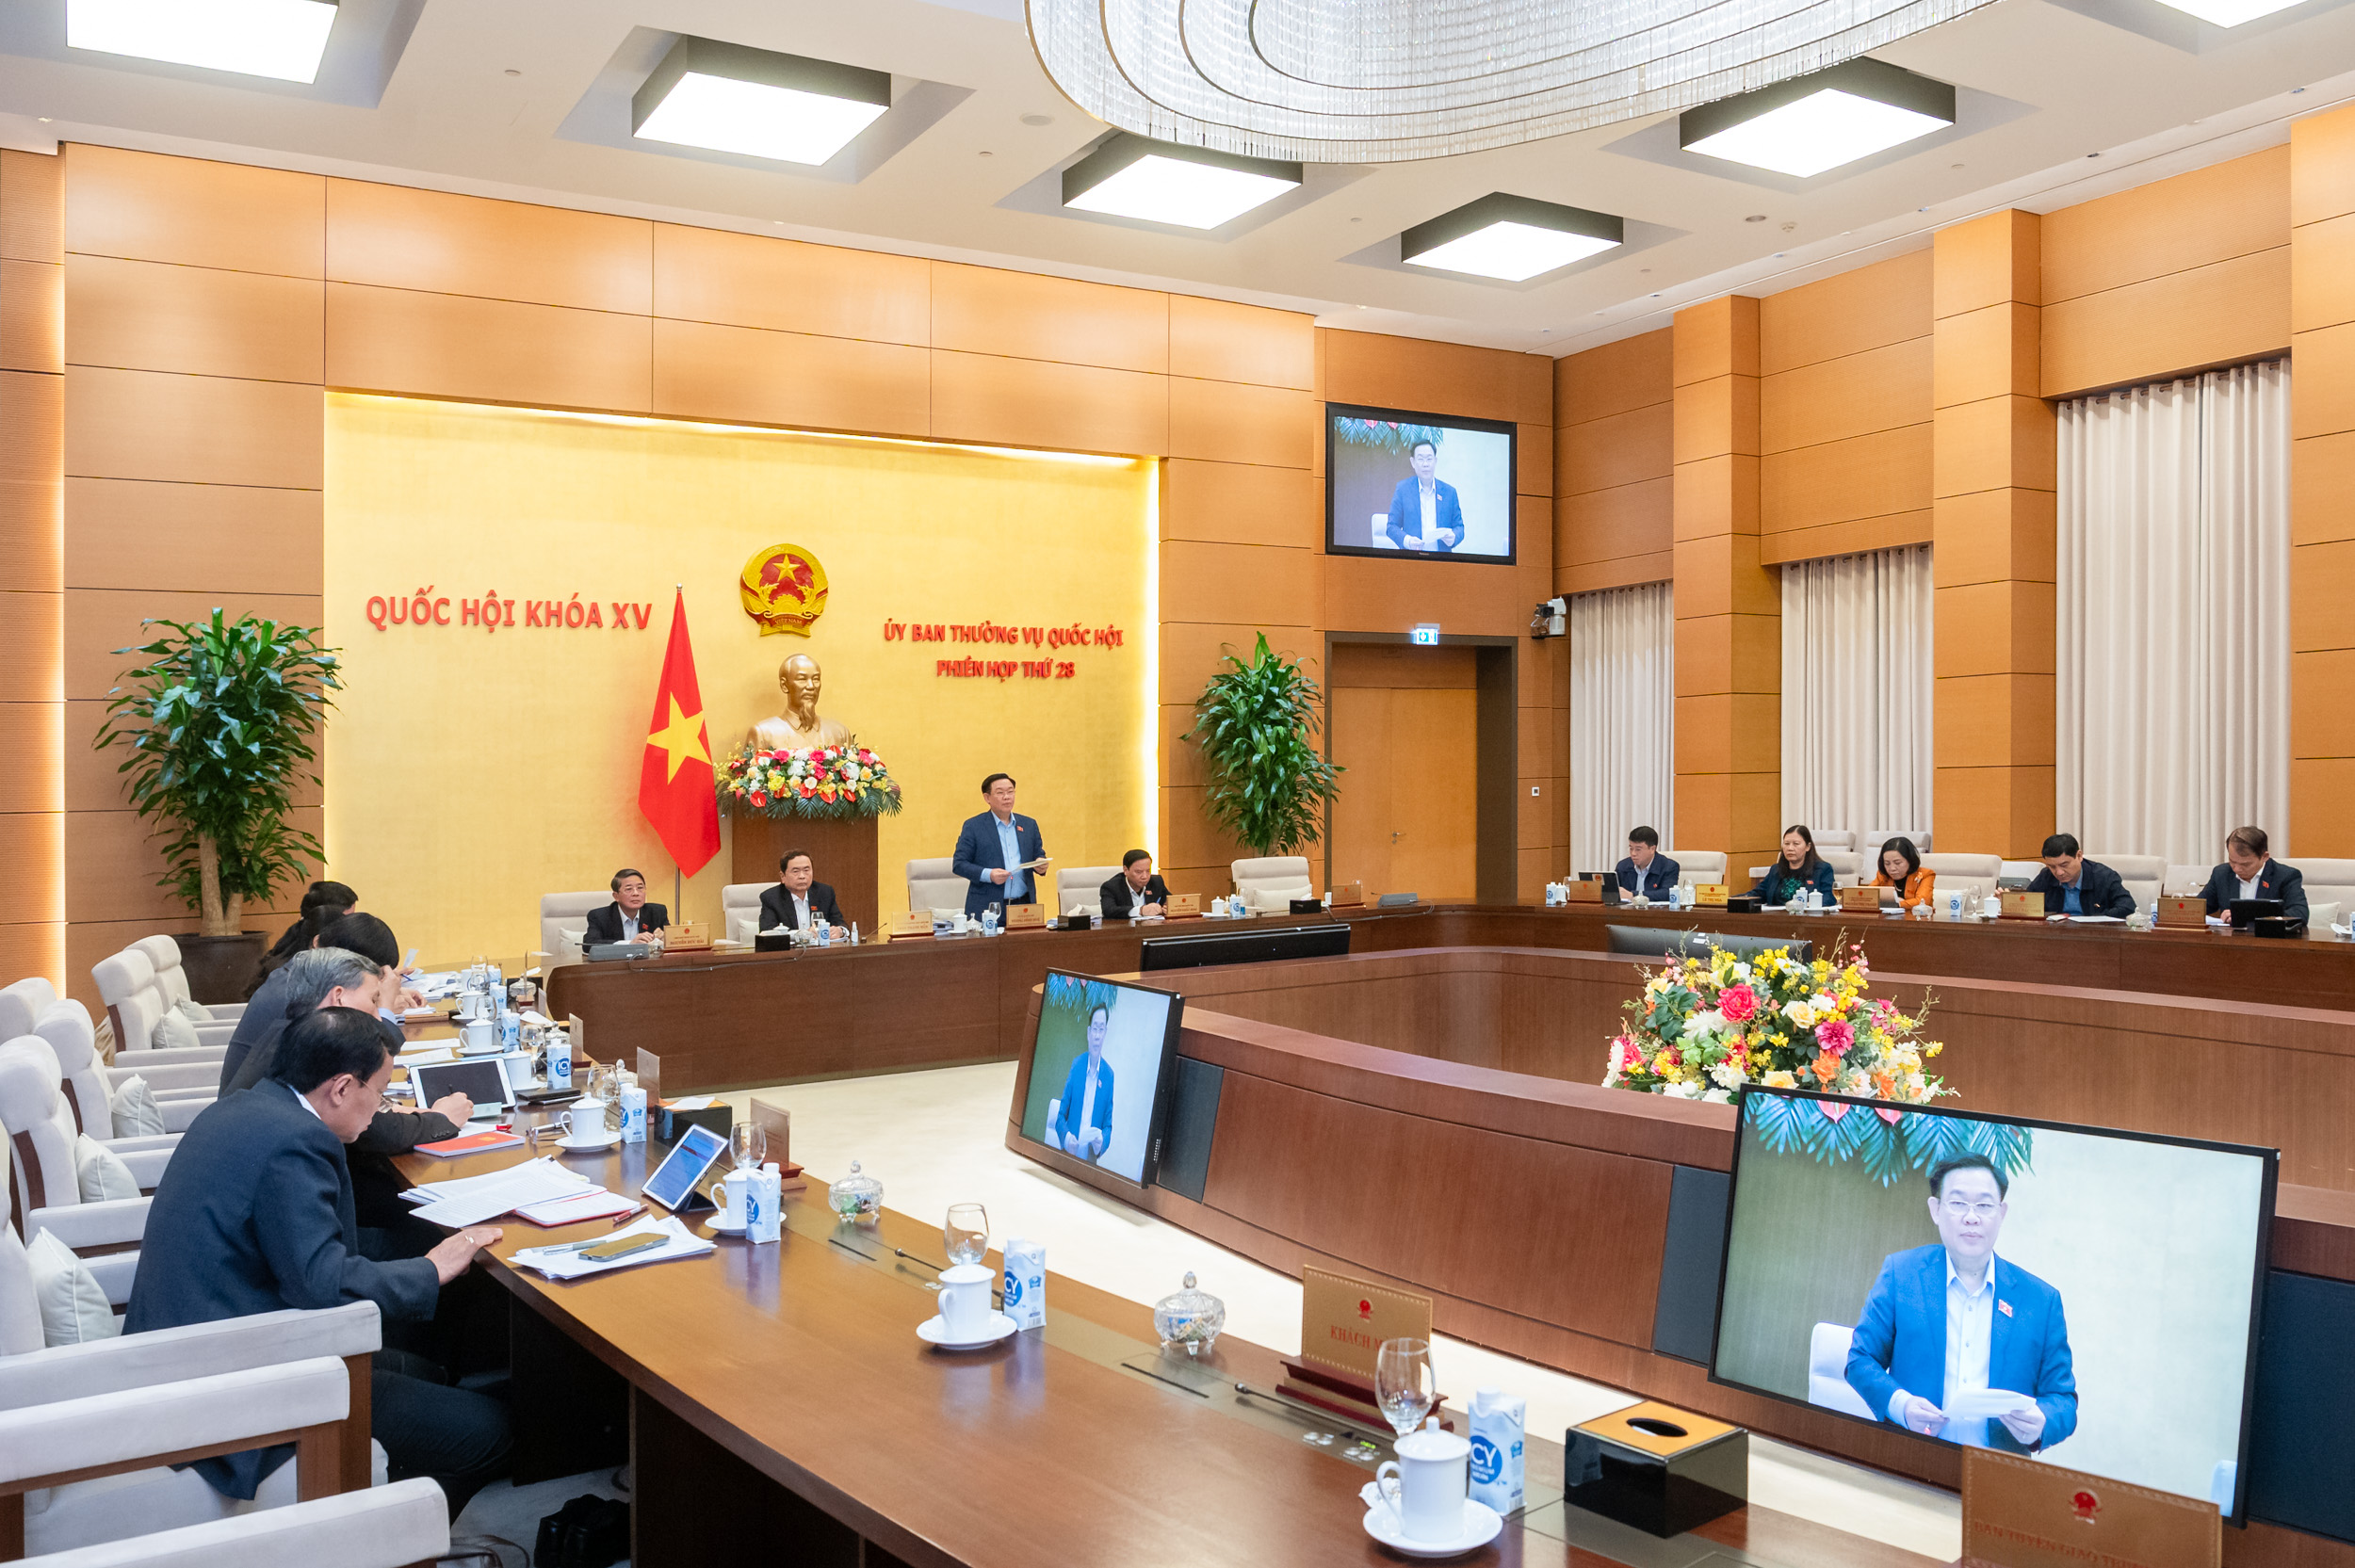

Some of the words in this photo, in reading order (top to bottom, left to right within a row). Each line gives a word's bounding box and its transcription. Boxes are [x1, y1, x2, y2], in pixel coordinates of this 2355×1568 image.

[366, 585, 450, 631] QUỐC
[462, 589, 515, 633] HỘI
[526, 592, 604, 628] KHÓA
[611, 602, 653, 630] XV
[884, 618, 907, 640] ỦY
[912, 623, 946, 642] BAN
[950, 620, 1018, 644] THƯỜNG
[1022, 626, 1045, 648] VỤ
[1048, 622, 1091, 649] QUỐC
[1094, 624, 1124, 651] HỘI
[936, 655, 984, 678] PHIÊN
[986, 660, 1018, 683] HỌP
[1020, 656, 1054, 678] THỨ
[1055, 661, 1076, 679] 28
[1004, 1277, 1018, 1294] CY
[1330, 1325, 1371, 1350] KHÁCH
[1471, 1443, 1498, 1467] CY
